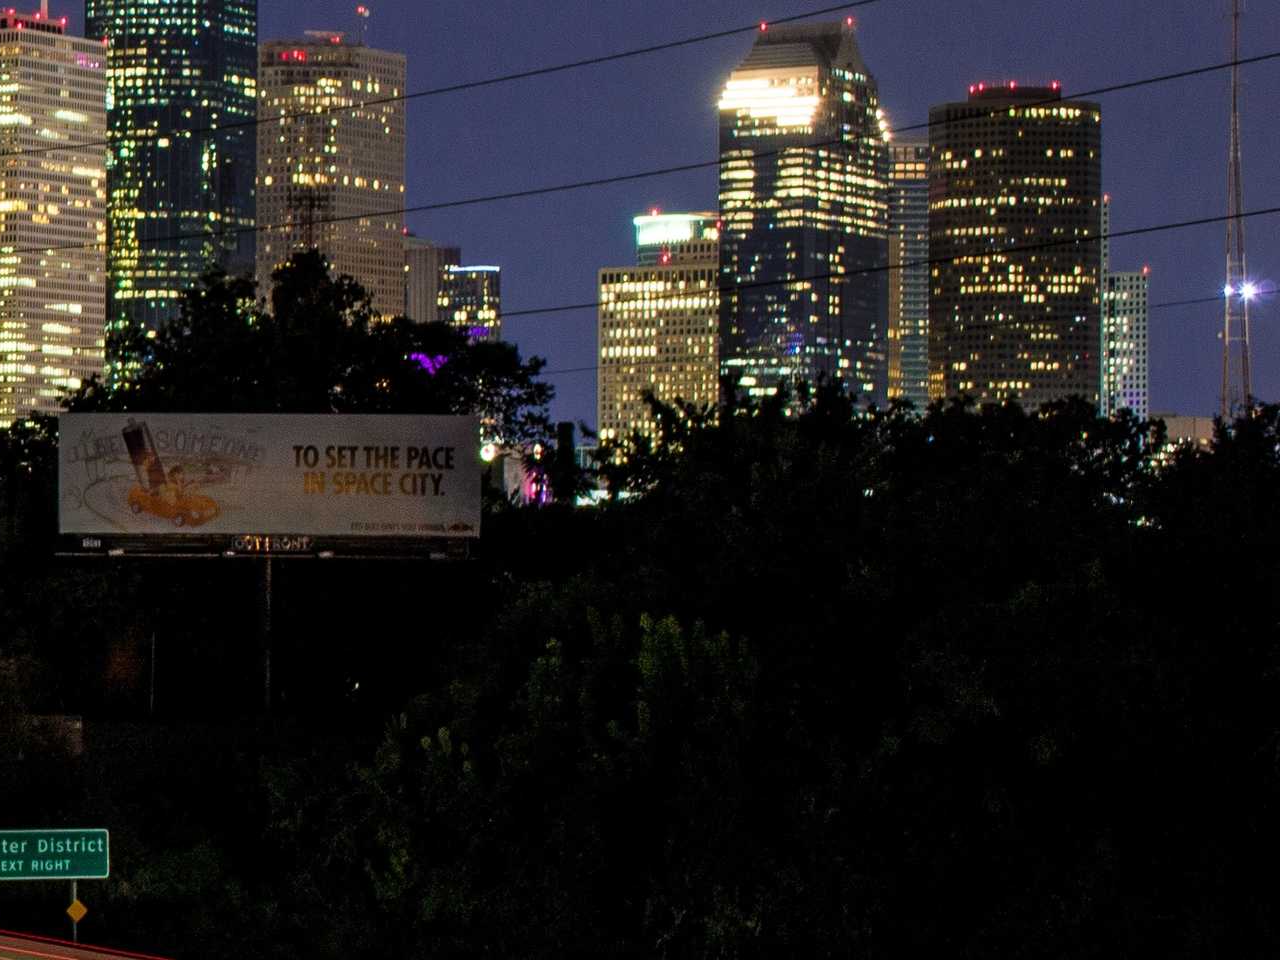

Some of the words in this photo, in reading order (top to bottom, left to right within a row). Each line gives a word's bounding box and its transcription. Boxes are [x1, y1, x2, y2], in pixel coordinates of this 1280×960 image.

[292, 445, 319, 468] TO
[326, 445, 358, 468] SET
[363, 445, 400, 469] THE
[406, 445, 455, 470] PACE
[303, 472, 325, 495] IN
[331, 472, 391, 496] SPACE
[399, 472, 445, 496] CITY.
[37, 836, 104, 853] District
[31, 859, 71, 871] RIGHT
